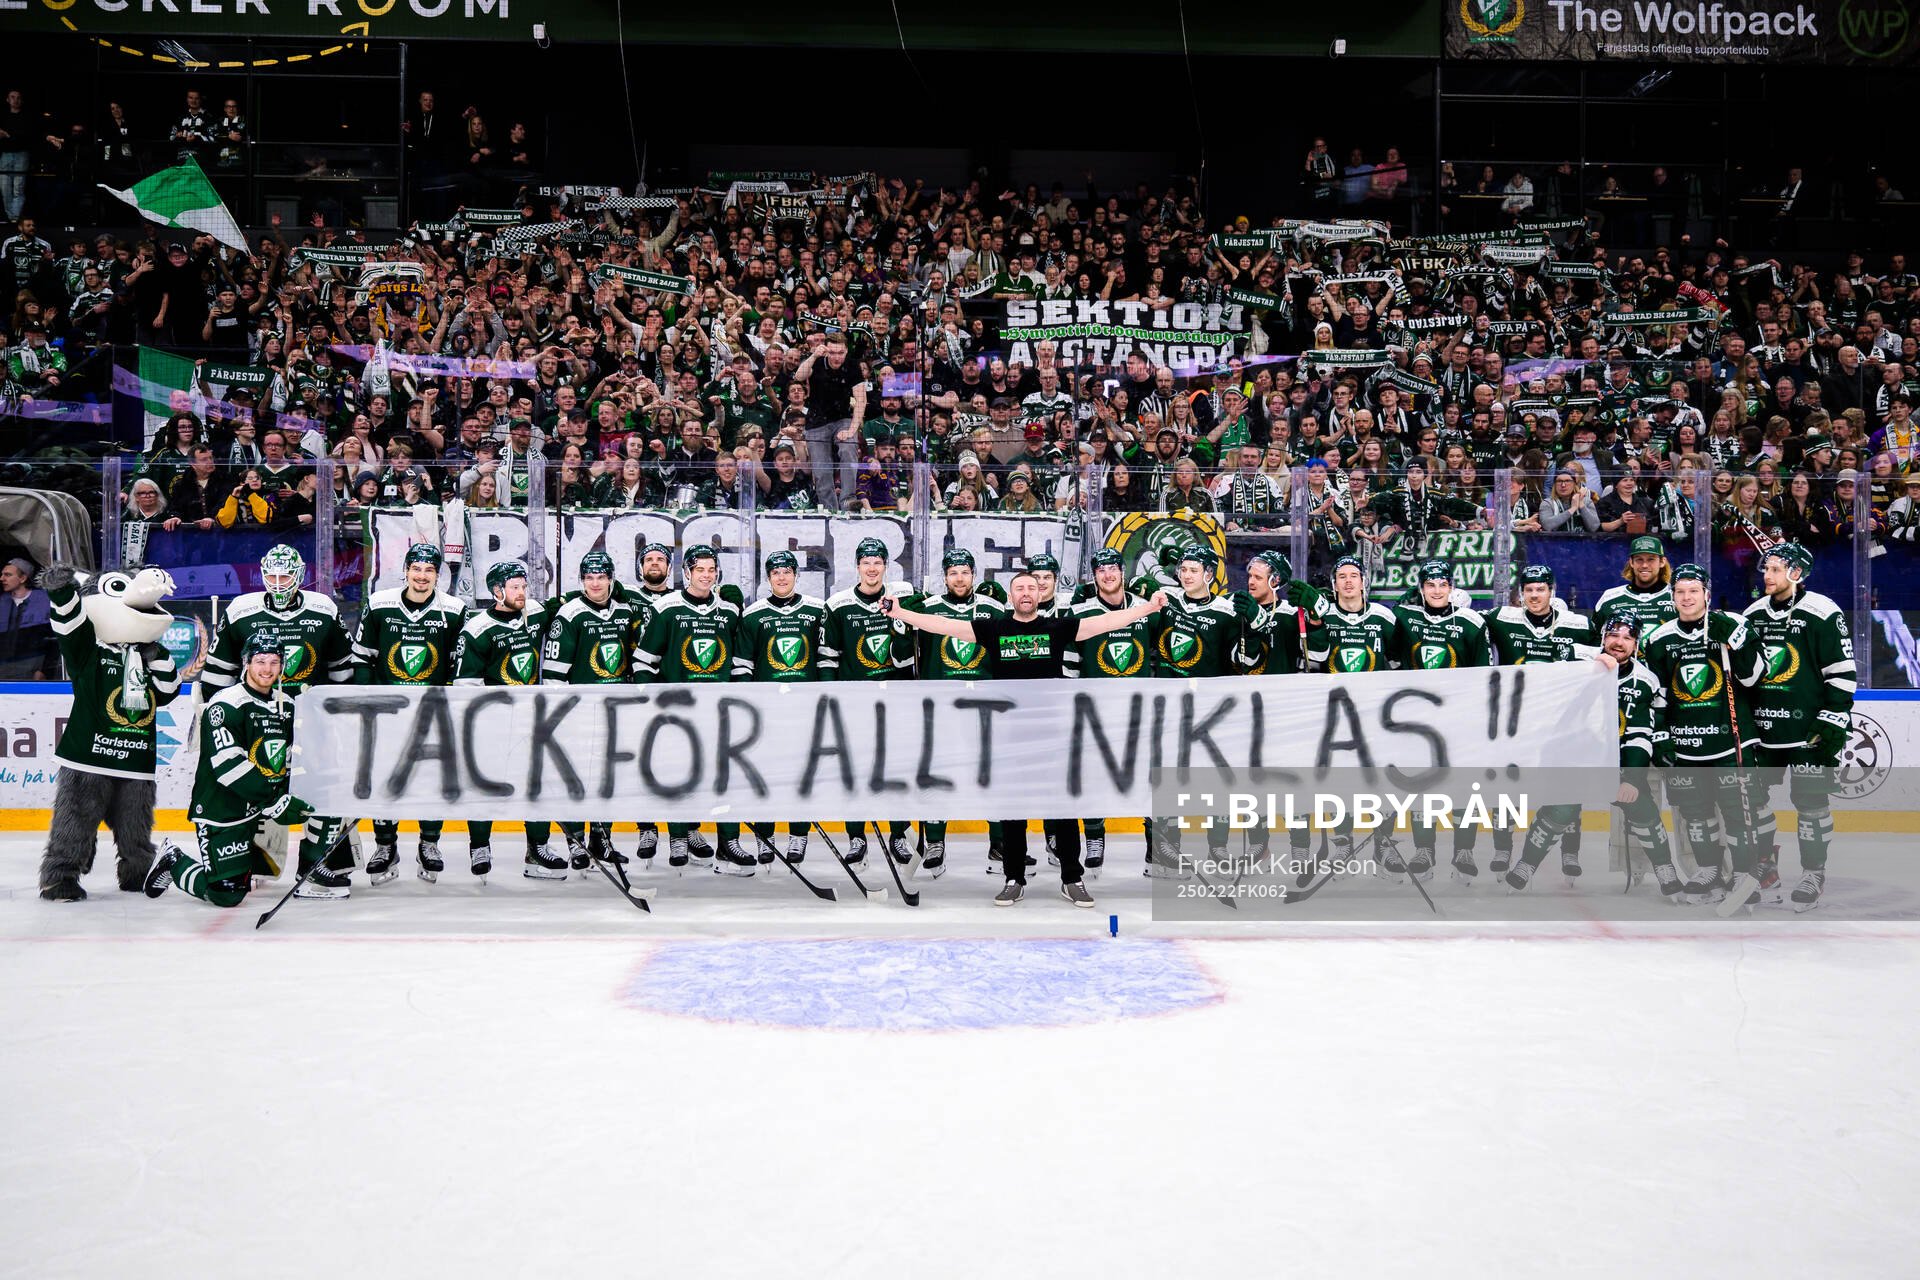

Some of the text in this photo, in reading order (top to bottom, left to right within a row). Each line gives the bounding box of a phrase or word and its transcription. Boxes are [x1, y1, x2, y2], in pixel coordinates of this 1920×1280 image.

[1548, 0, 1819, 42] The Wolfpack
[1596, 42, 1770, 57] Färjestads officiella supporterklubb
[1224, 238, 1264, 247] FÄRJESTAD
[1411, 258, 1445, 270] FBK
[605, 268, 646, 283] FÄRJESTAD
[1232, 291, 1275, 307] FÄRJESTAD
[1408, 315, 1468, 329] FÄRJESTAD
[1607, 311, 1651, 321] FÄRJESTAD
[1665, 310, 1688, 319] 24/25
[1008, 337, 1235, 370] ASTÄNGDA
[211, 368, 266, 382] FÄRJESTAD
[299, 619, 323, 627] coop
[424, 620, 444, 628] coop
[797, 613, 816, 622] coop
[1196, 615, 1217, 625] coop
[1373, 637, 1382, 653] A
[1551, 636, 1574, 644] coop
[545, 640, 560, 659] 98
[322, 669, 1526, 803] TACK FÖR ALLT NIKLAS !!
[1670, 724, 1720, 735] Karlstads
[93, 733, 149, 751] Karlstads
[212, 727, 235, 751] 20
[91, 744, 130, 760] Energi
[22, 765, 45, 789] på
[216, 841, 250, 858] voky
